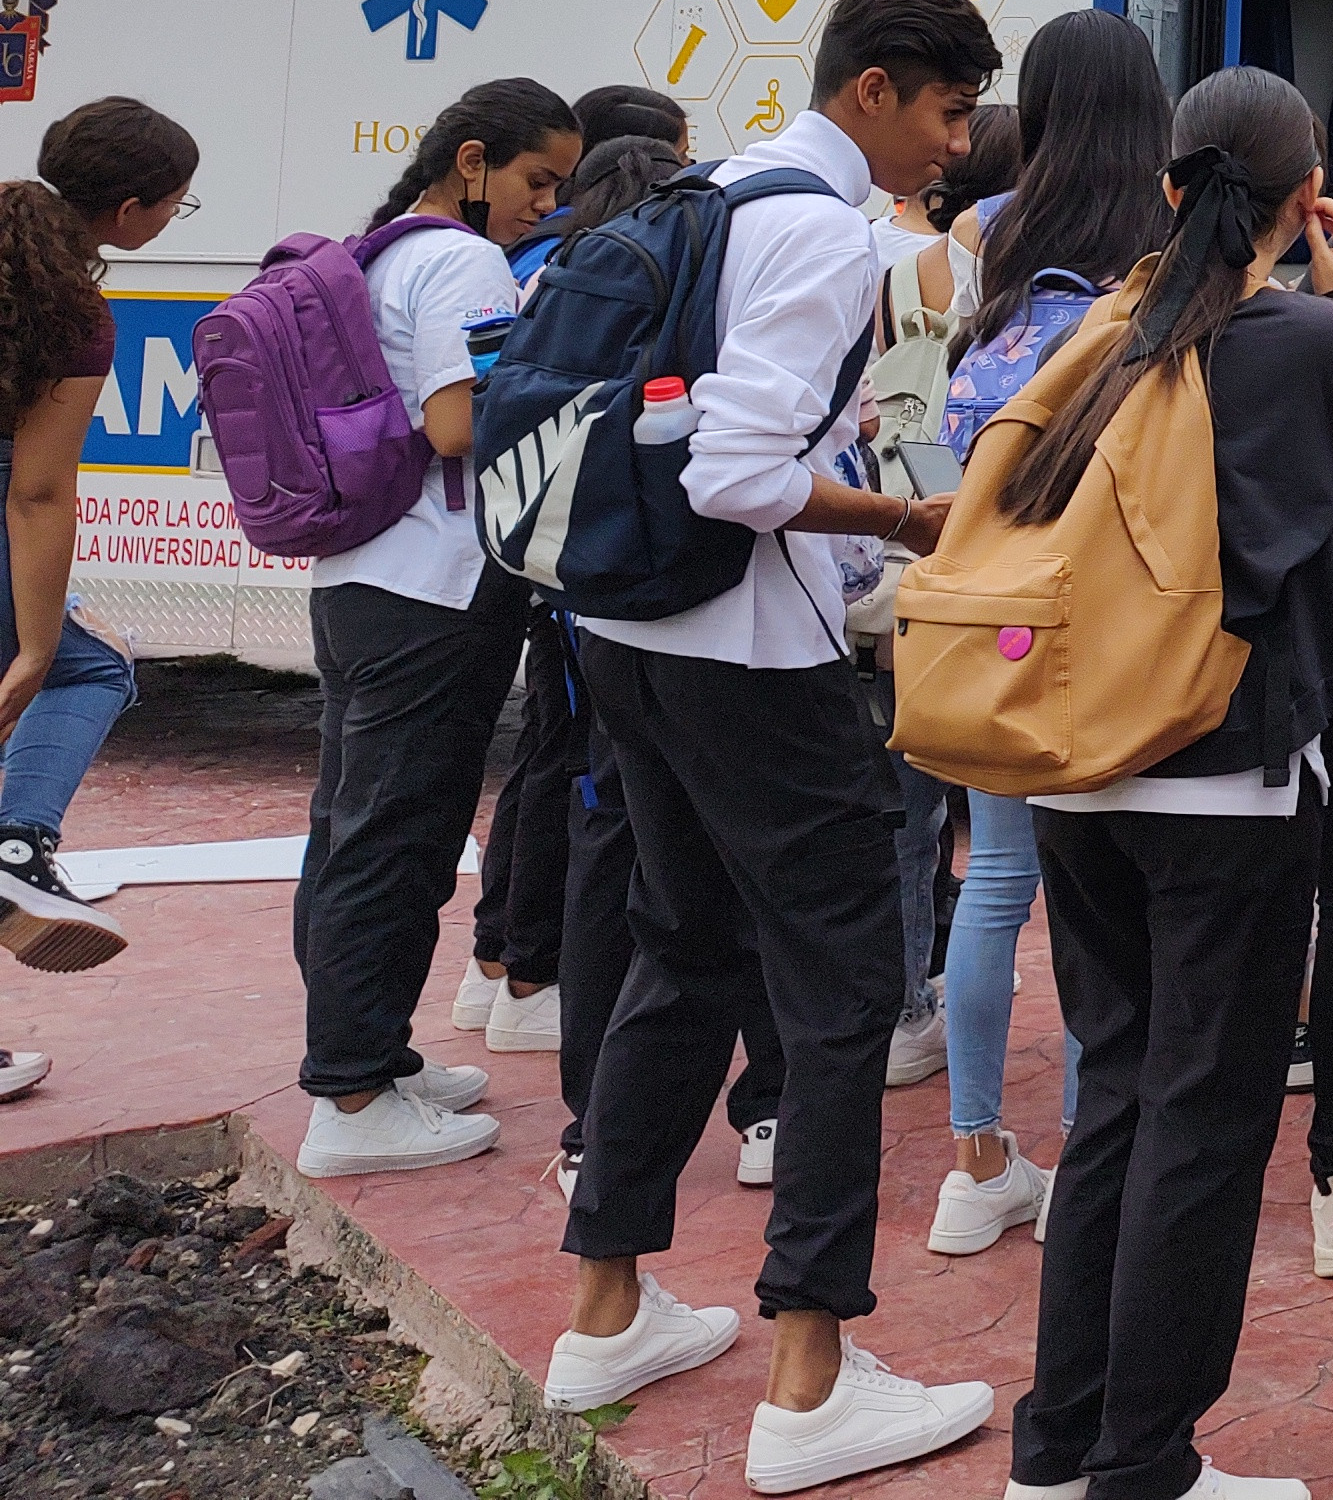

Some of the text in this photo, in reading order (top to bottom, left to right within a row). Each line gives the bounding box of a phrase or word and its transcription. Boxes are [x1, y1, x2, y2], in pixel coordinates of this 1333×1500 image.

[118, 498, 160, 527] POR
[166, 500, 191, 528] LA
[76, 534, 101, 563] LA
[107, 535, 242, 568] UNIVERSIDAD
